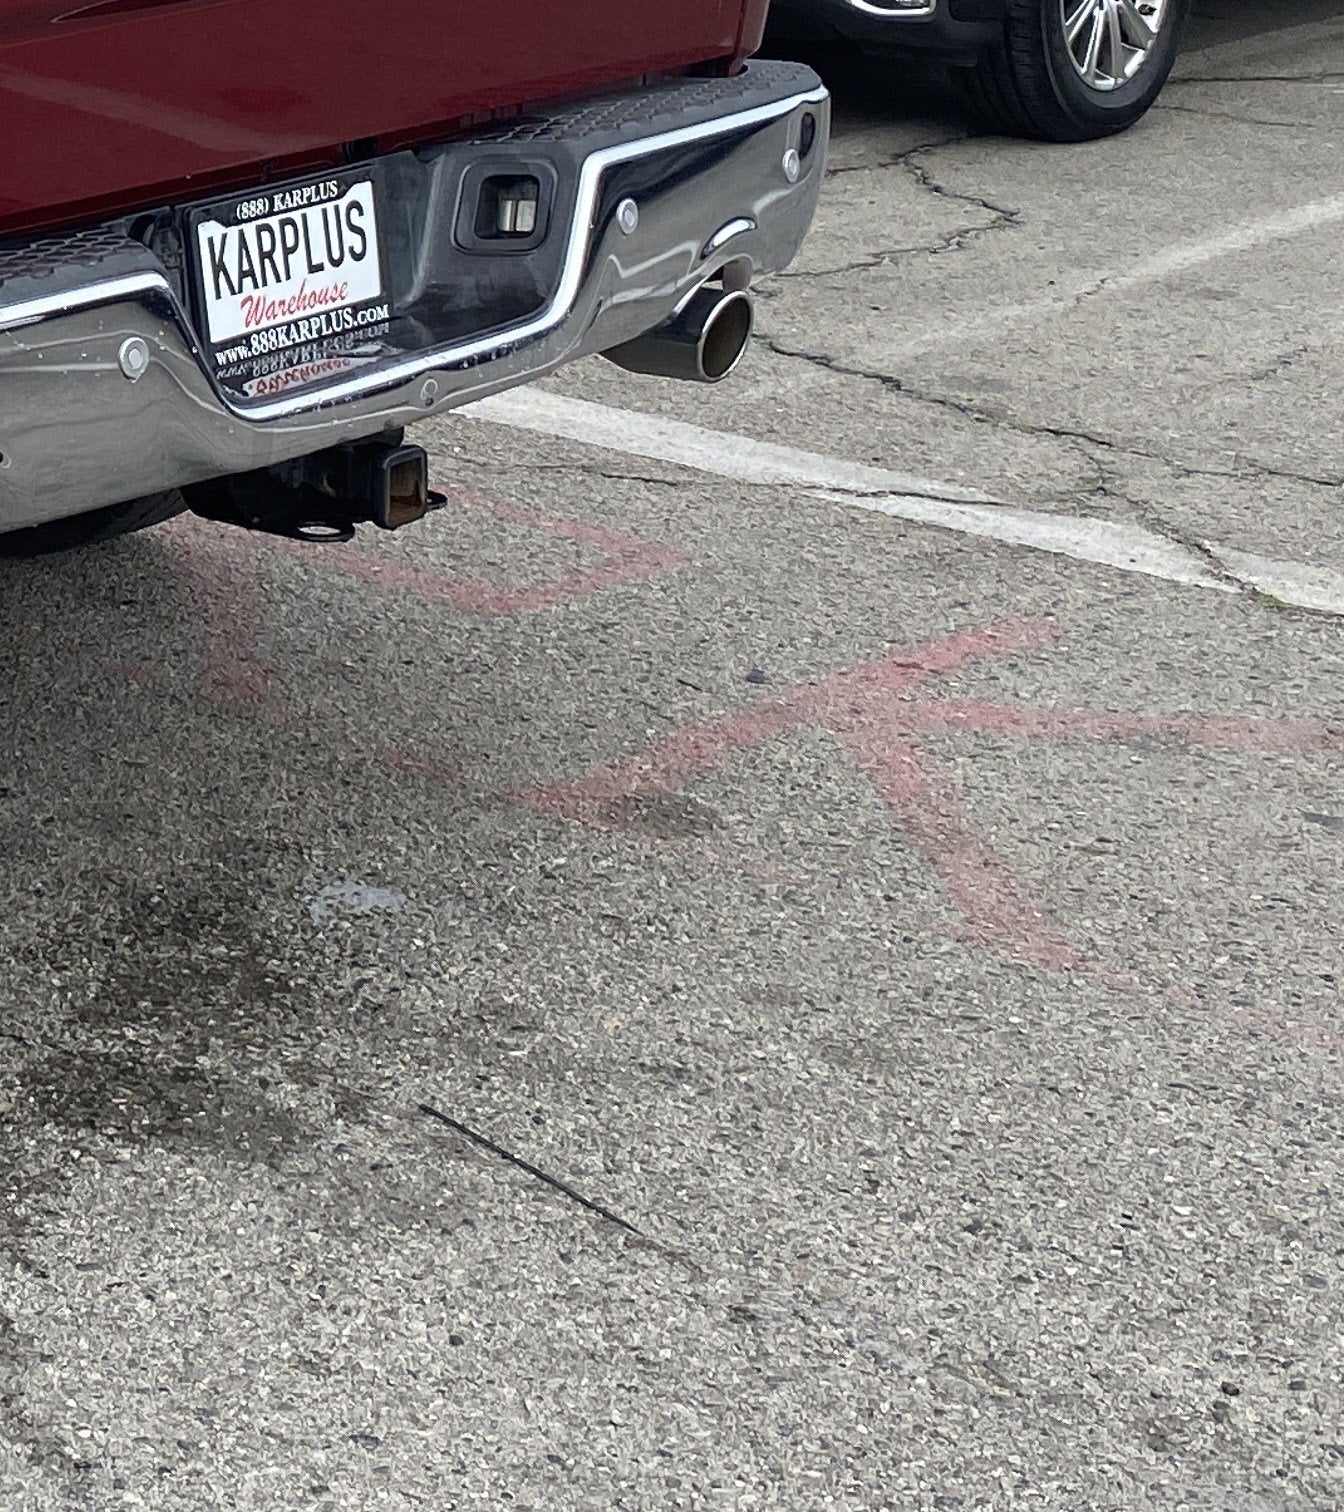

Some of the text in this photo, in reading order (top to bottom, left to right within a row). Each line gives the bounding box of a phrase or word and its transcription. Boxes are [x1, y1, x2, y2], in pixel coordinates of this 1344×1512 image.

[236, 180, 338, 221] (888) KARPLUS
[207, 199, 368, 301] KARPLUS
[240, 277, 348, 329] Warehouse
